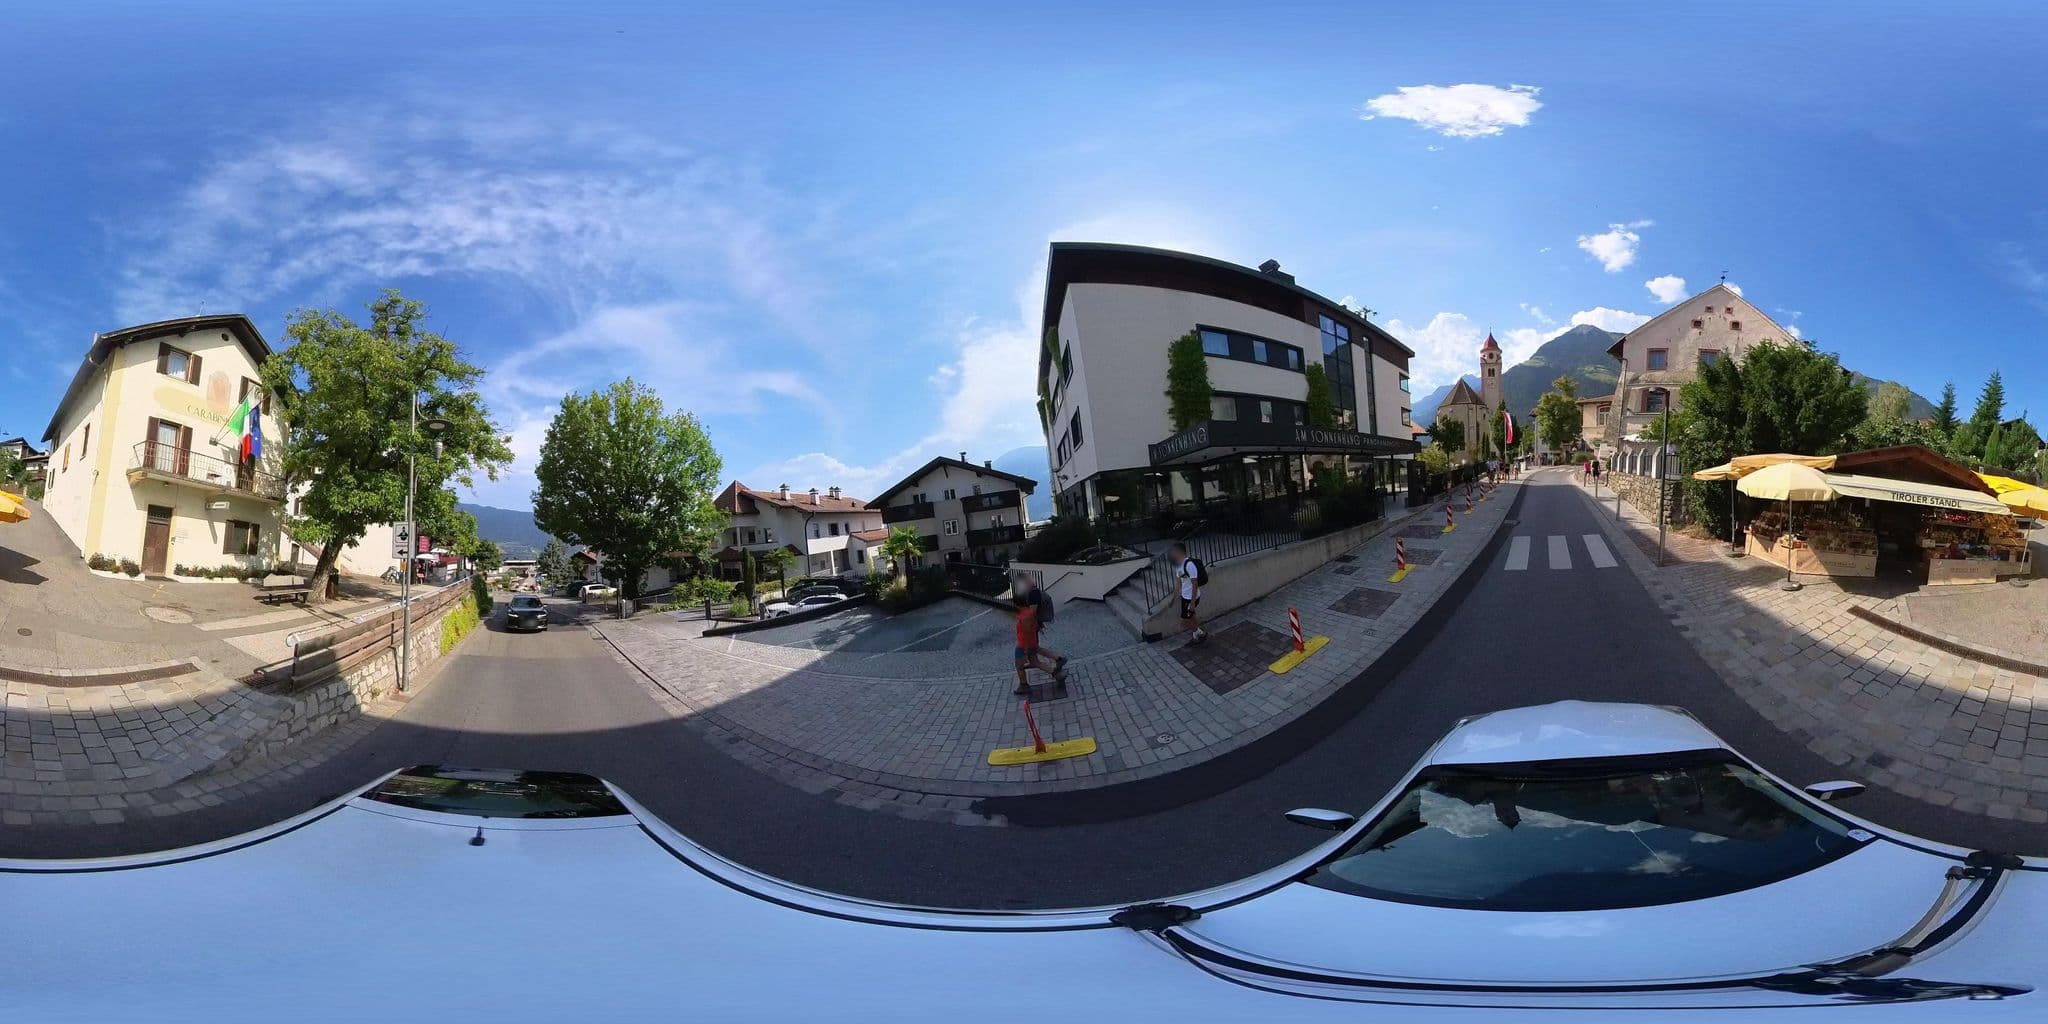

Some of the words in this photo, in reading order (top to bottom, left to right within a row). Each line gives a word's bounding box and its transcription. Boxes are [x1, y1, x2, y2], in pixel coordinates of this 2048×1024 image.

[1295, 429, 1308, 442] AM
[1311, 430, 1360, 446] SONNENHANG
[1891, 492, 1928, 504] TIROLER
[1929, 496, 1962, 508] STANDL
